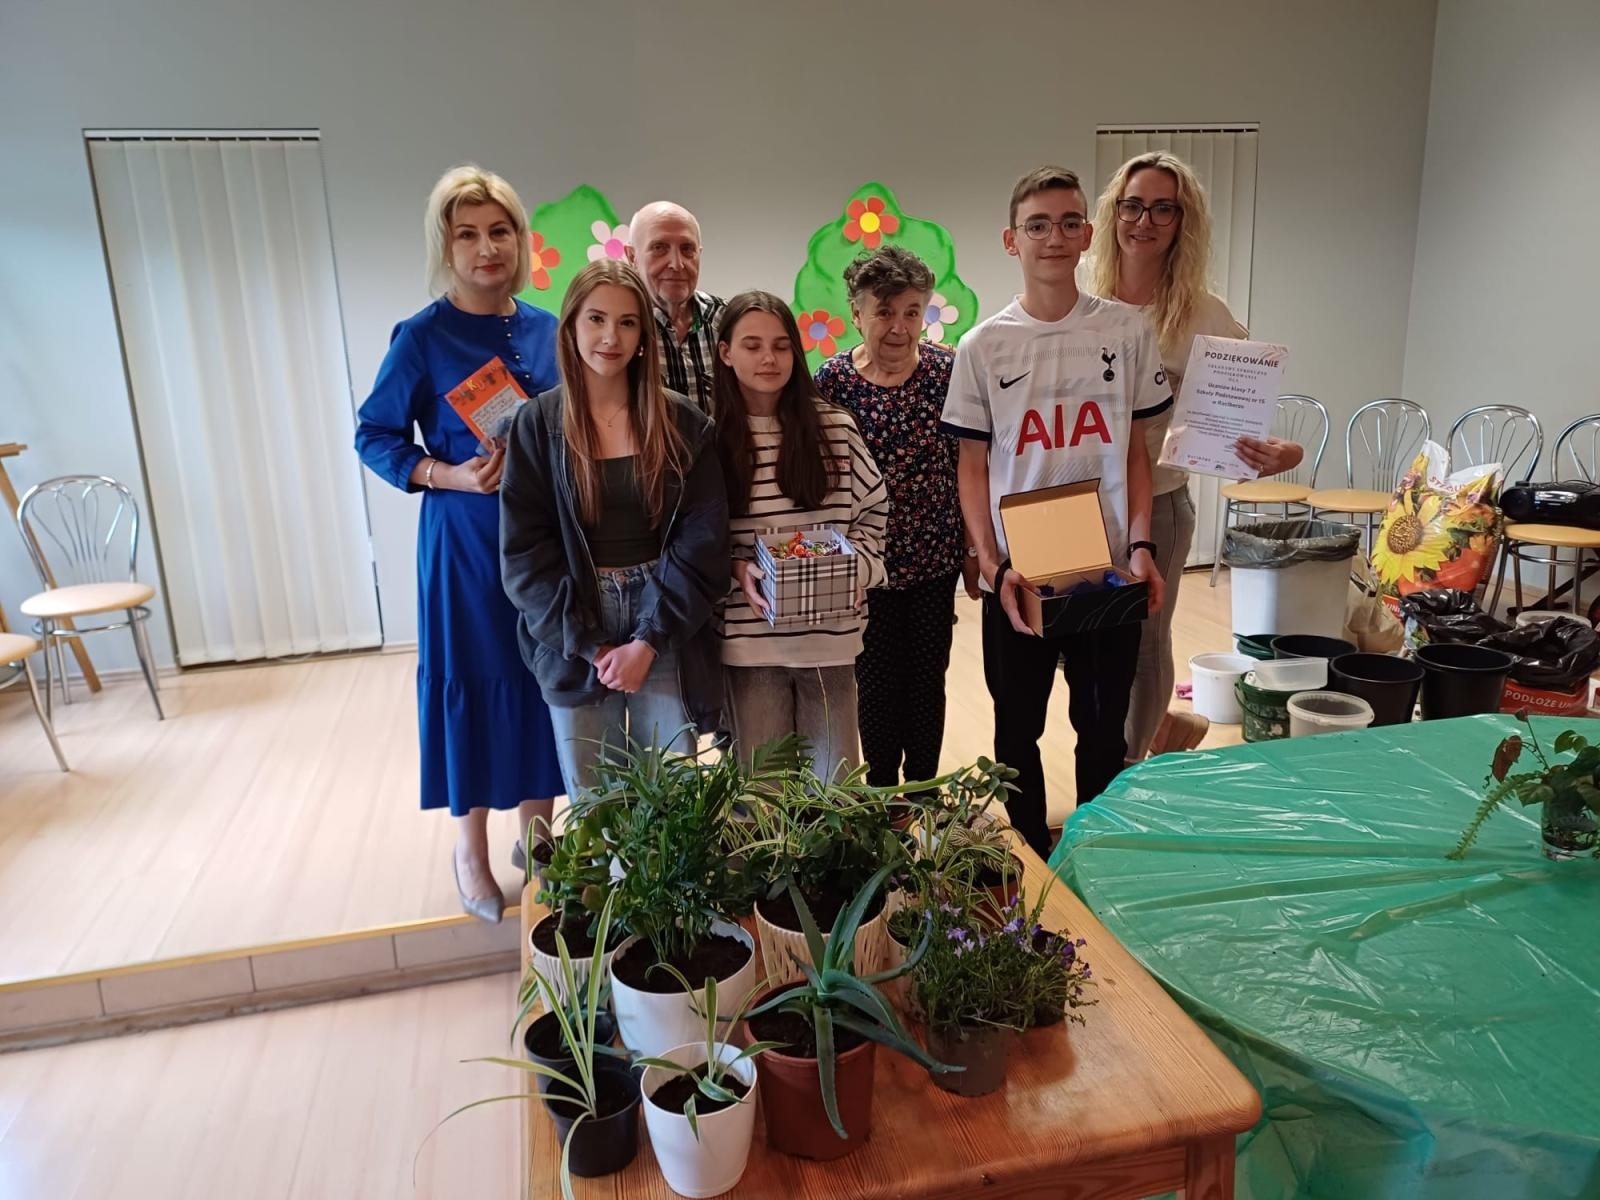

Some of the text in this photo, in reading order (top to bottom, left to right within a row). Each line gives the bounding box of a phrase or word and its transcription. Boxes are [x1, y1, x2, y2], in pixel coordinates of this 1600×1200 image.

[1204, 351, 1279, 368] PODZIĘKOWANIE
[1215, 391, 1251, 403] Podstawowej
[1231, 385, 1246, 394] klasy
[1015, 400, 1113, 457] AIA
[1503, 689, 1559, 708] PODŁOŻE
